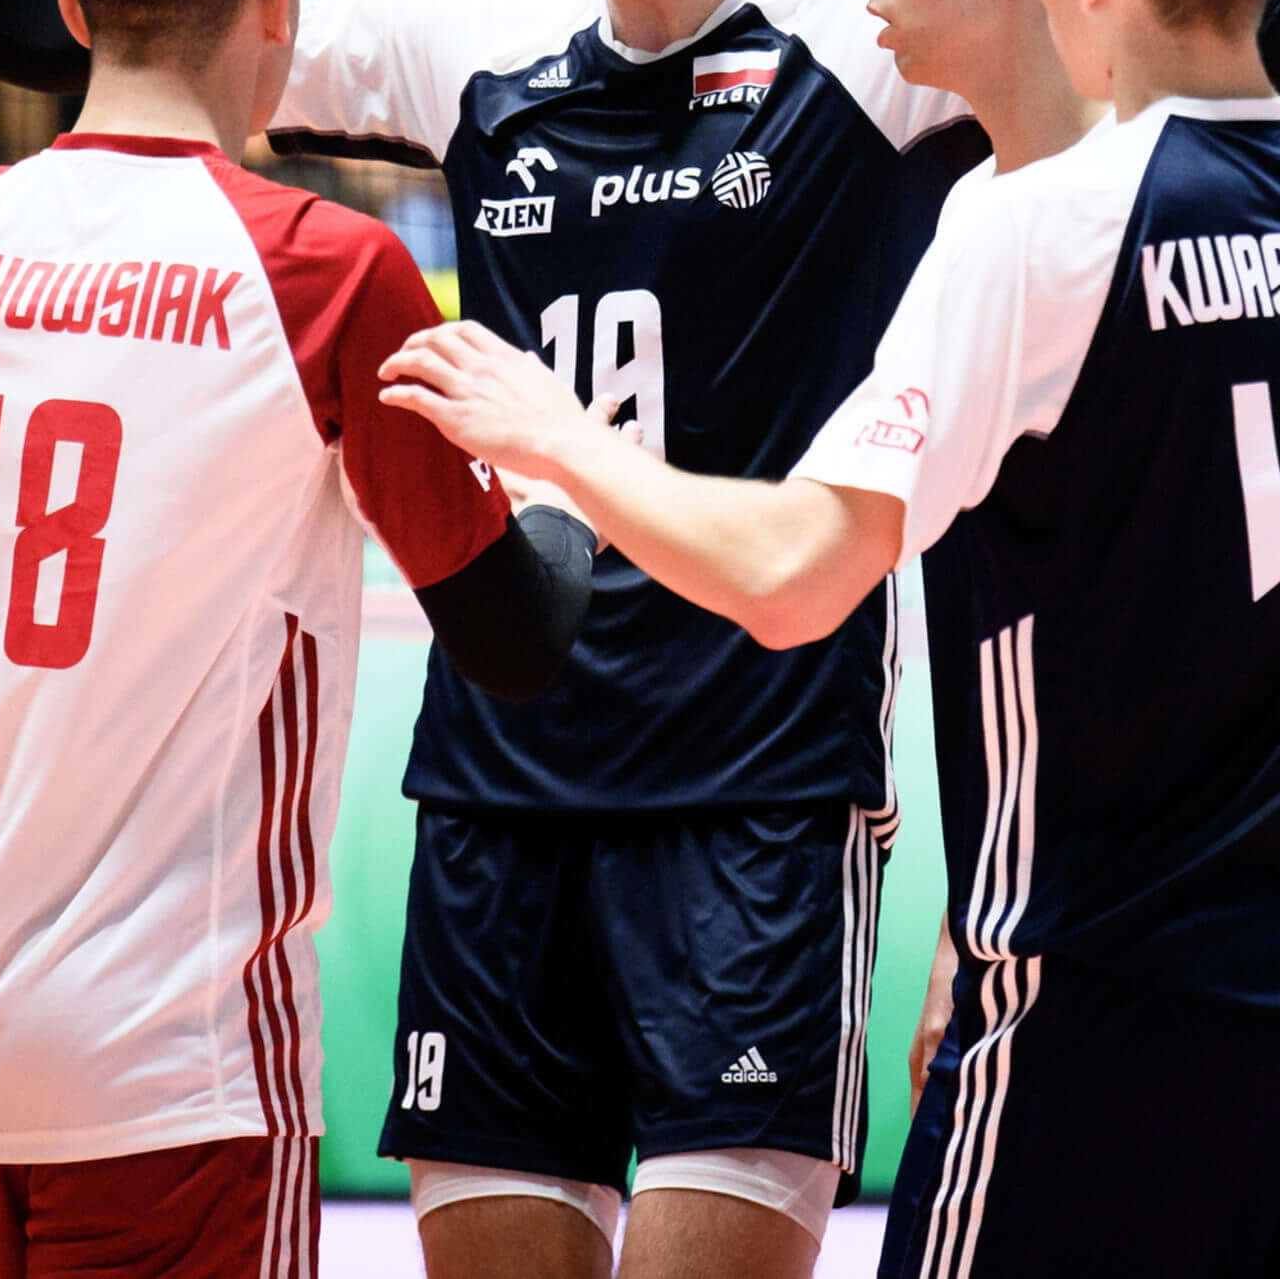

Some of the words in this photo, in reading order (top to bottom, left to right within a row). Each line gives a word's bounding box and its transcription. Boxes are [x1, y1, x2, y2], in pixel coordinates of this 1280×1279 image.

[528, 78, 572, 89] adidas
[591, 164, 702, 217] plus
[483, 203, 546, 231] RLEN
[401, 1031, 447, 1111] 19
[721, 1068, 778, 1083] adidas
